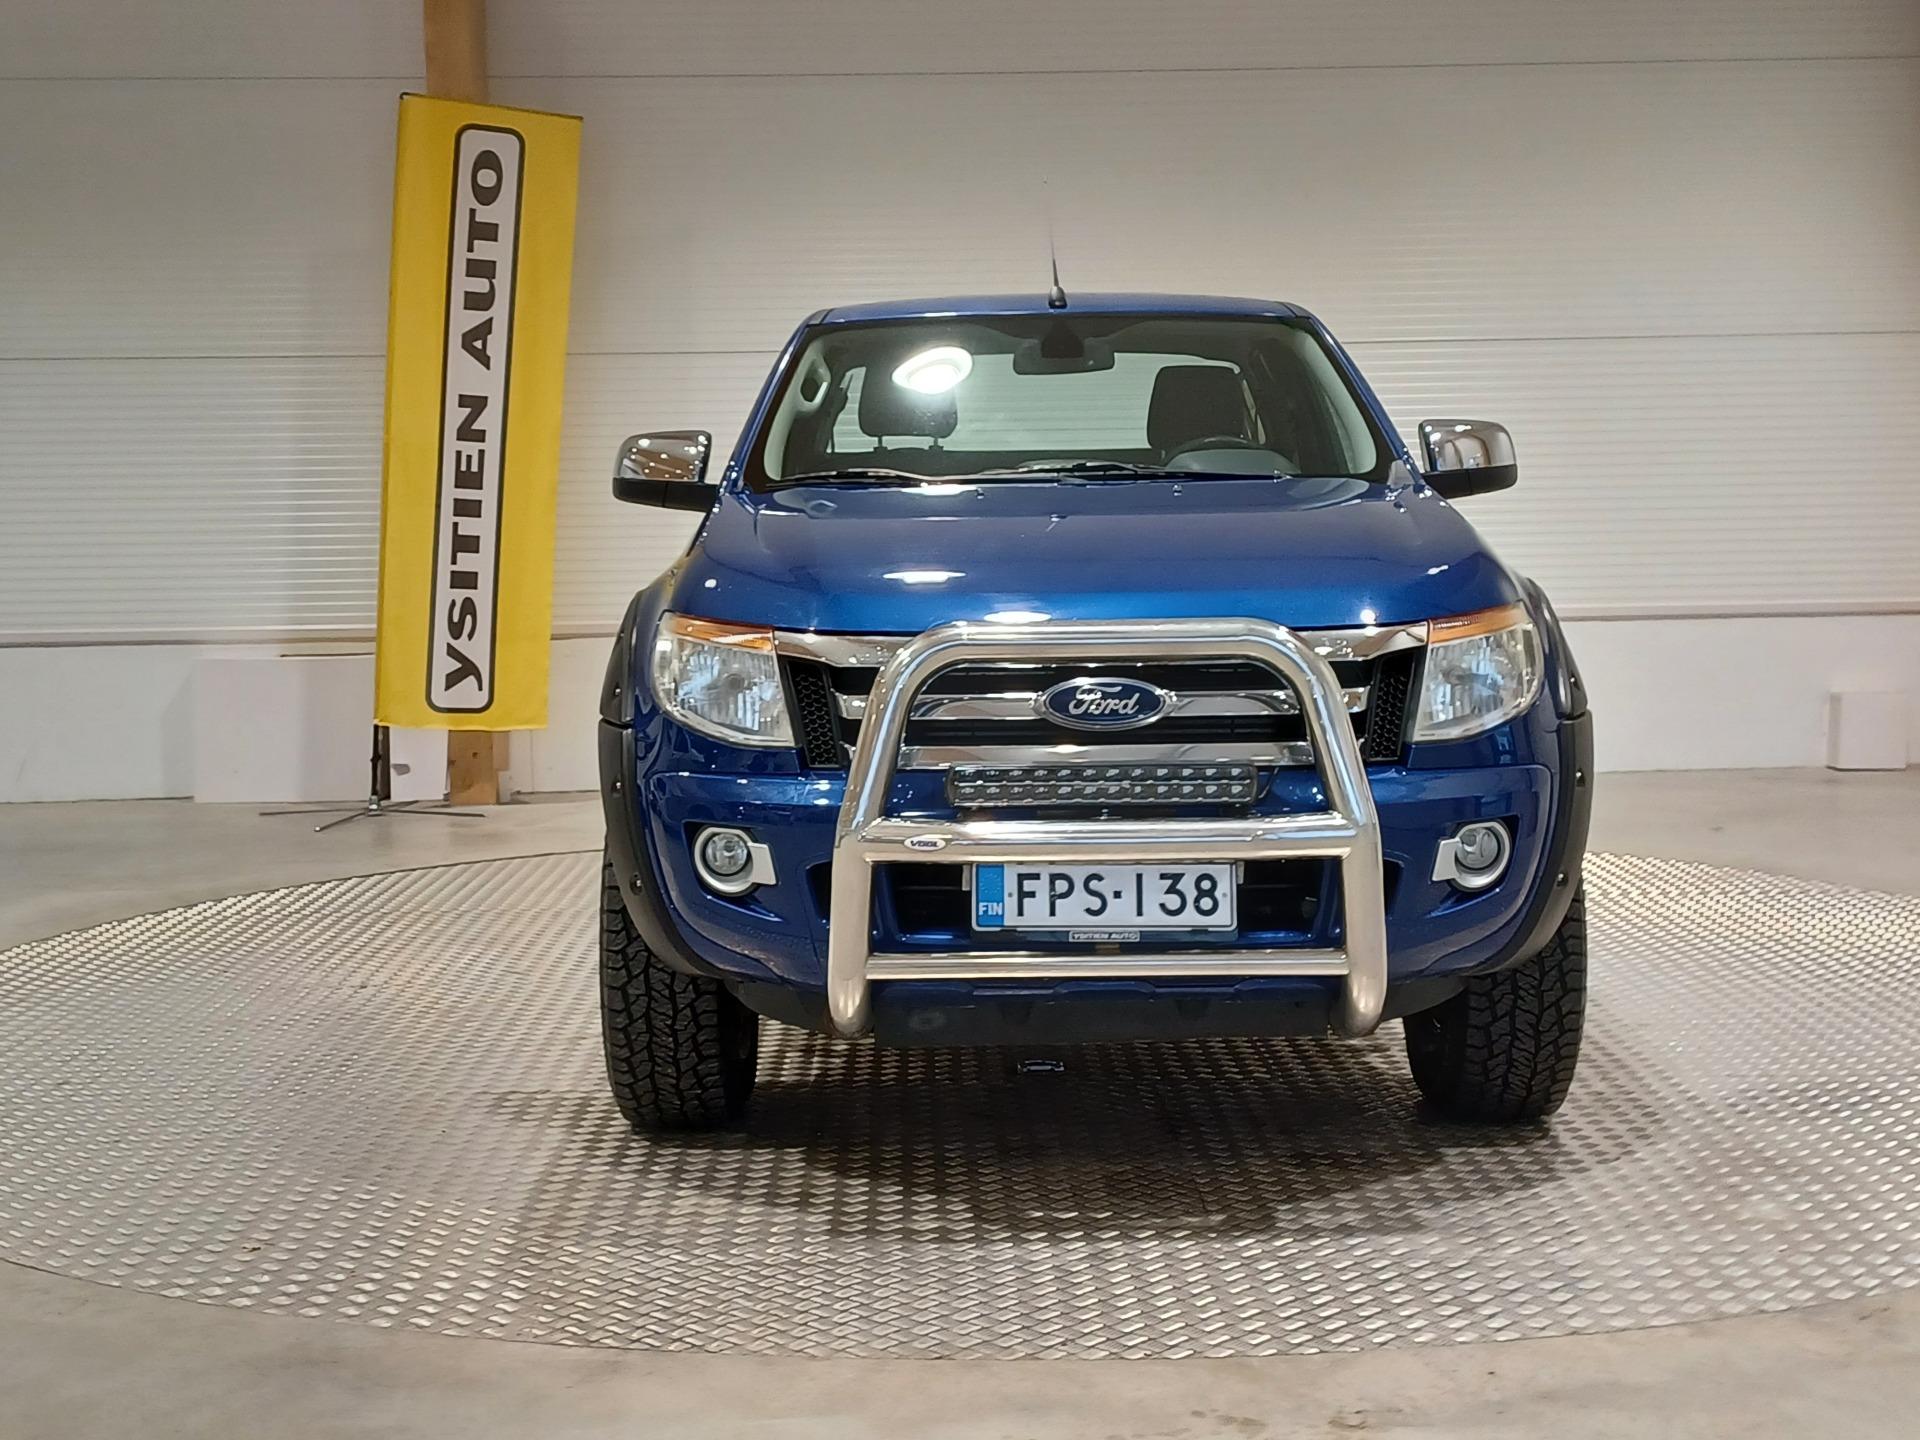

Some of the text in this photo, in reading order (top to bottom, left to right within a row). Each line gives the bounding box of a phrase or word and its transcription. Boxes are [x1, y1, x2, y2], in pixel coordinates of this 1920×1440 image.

[445, 149, 503, 692] YSITIEN AUTO
[1068, 684, 1140, 715] Ford
[978, 902, 1003, 916] FIN
